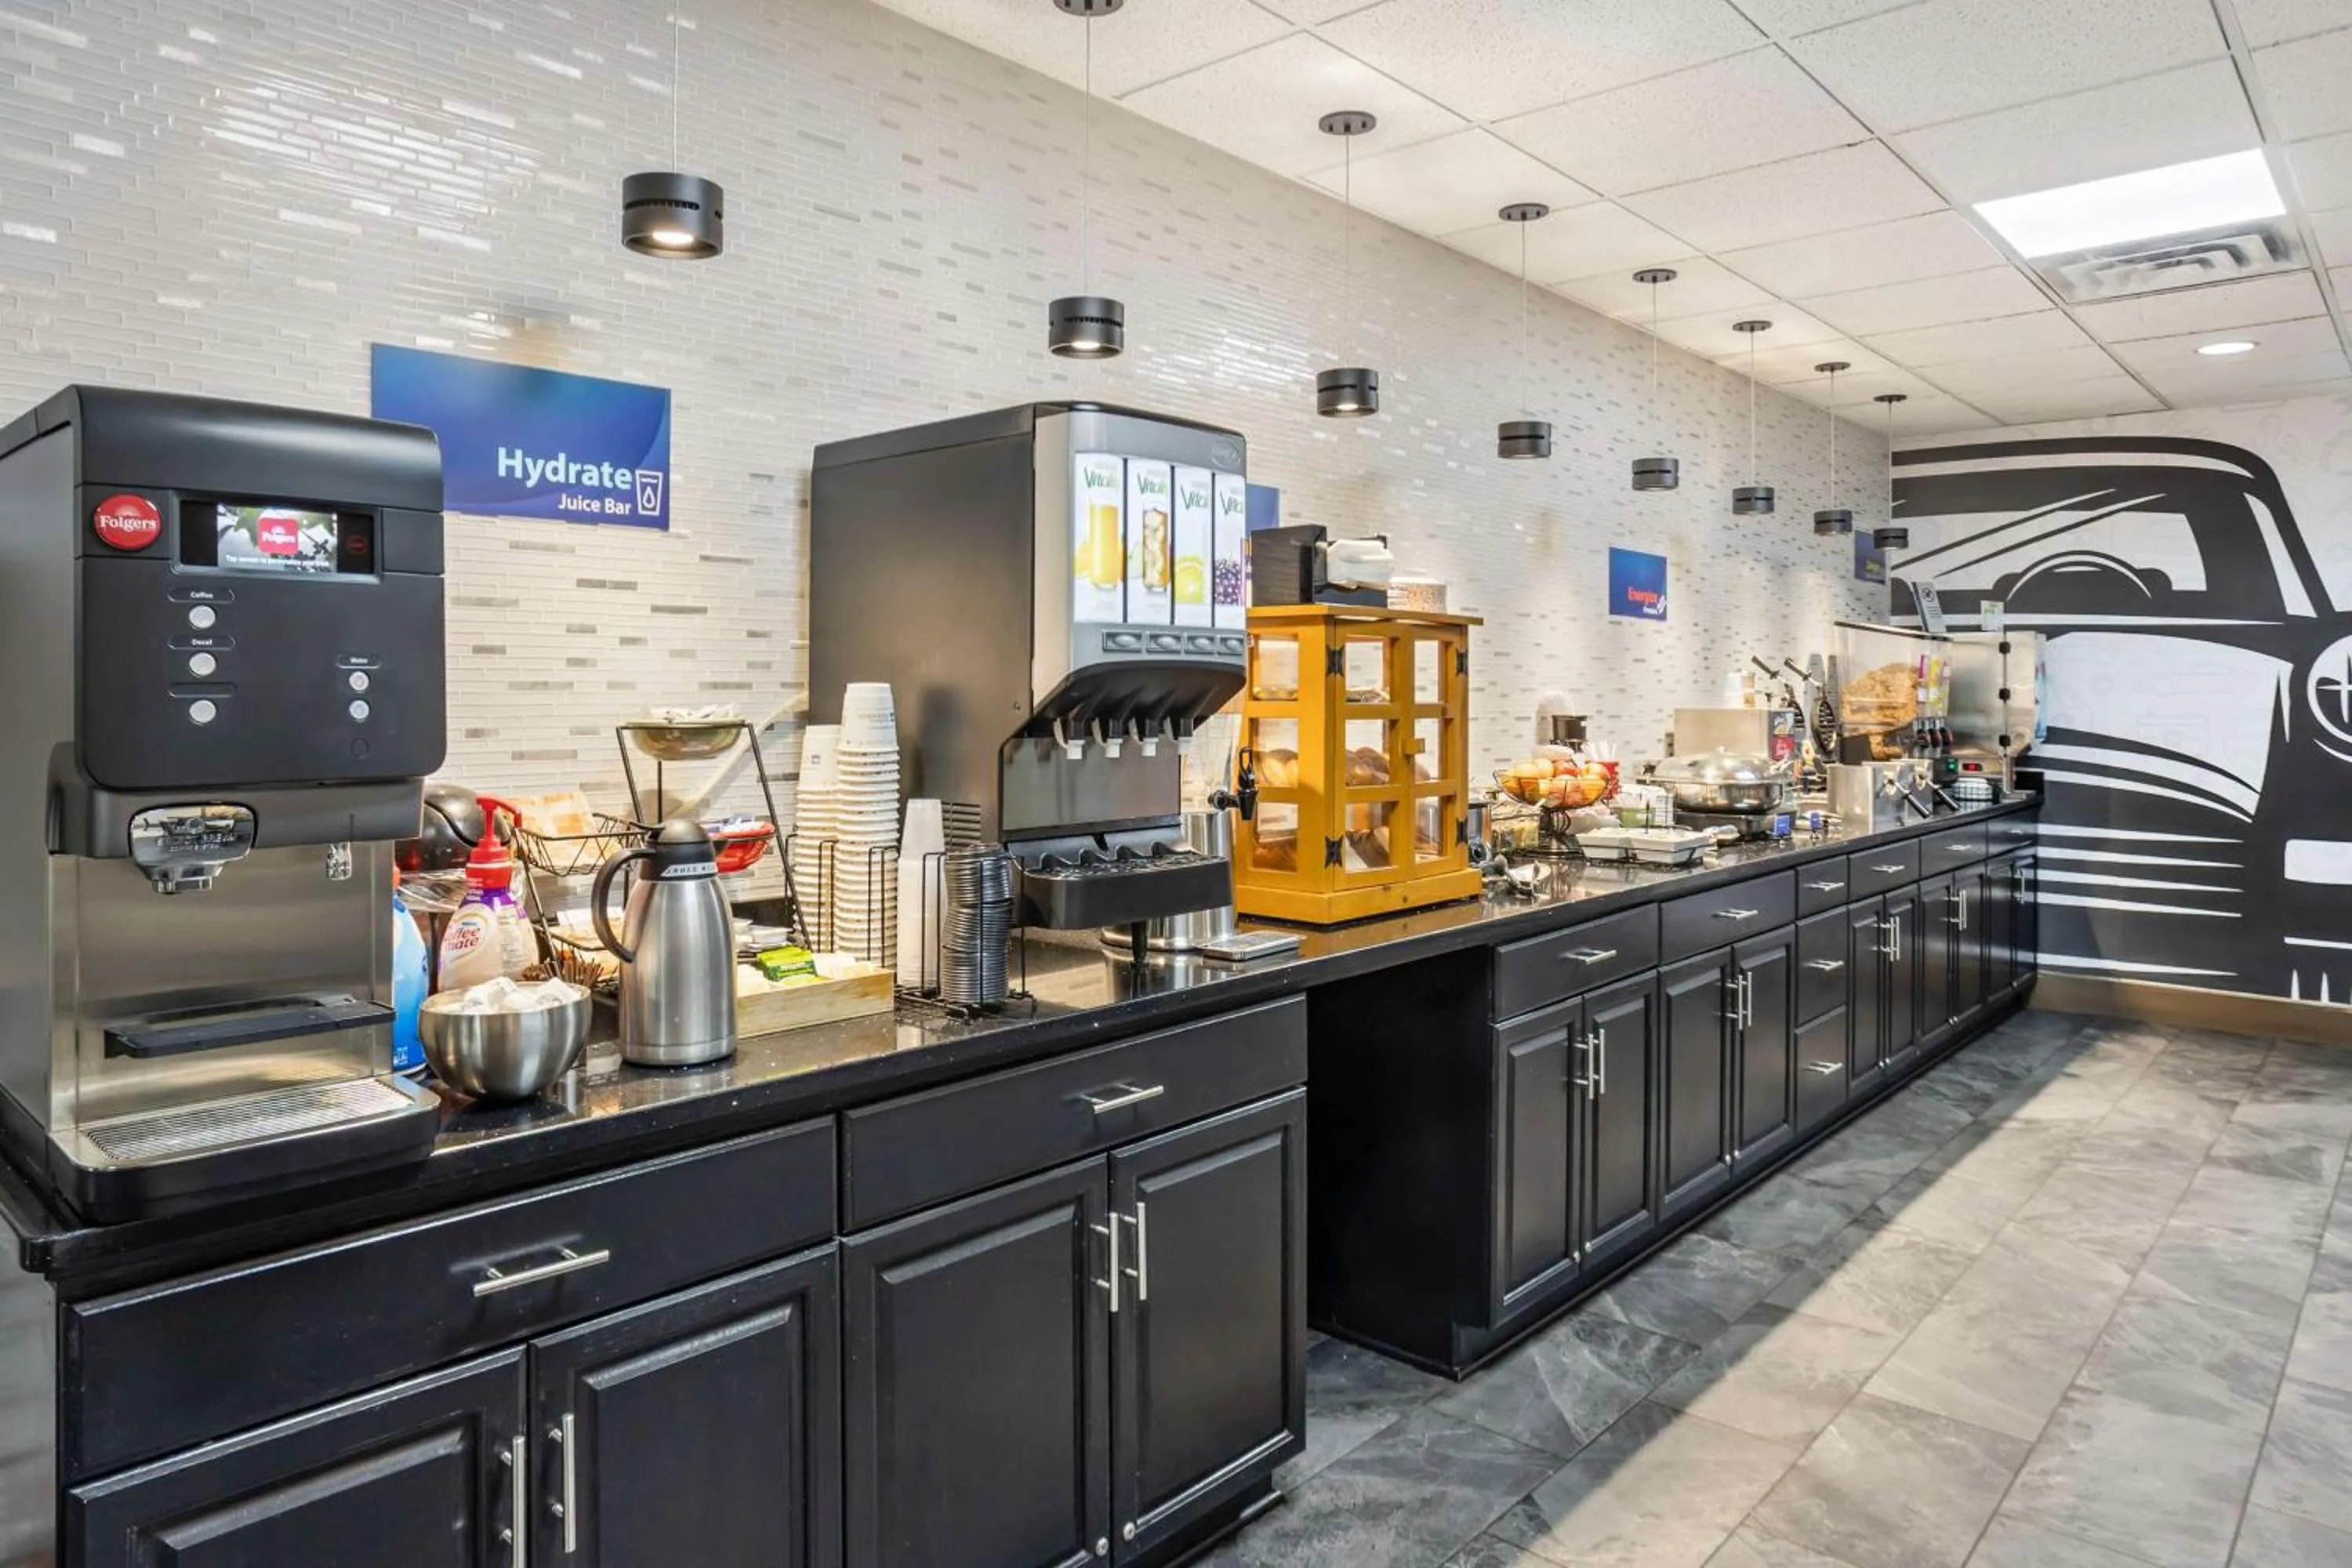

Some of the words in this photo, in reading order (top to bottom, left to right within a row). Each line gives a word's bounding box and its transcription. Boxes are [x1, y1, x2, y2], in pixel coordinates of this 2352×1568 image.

[497, 447, 633, 490] Hydrate
[557, 493, 601, 512] Juice
[604, 498, 632, 515] Bar
[100, 514, 156, 532] Folgers
